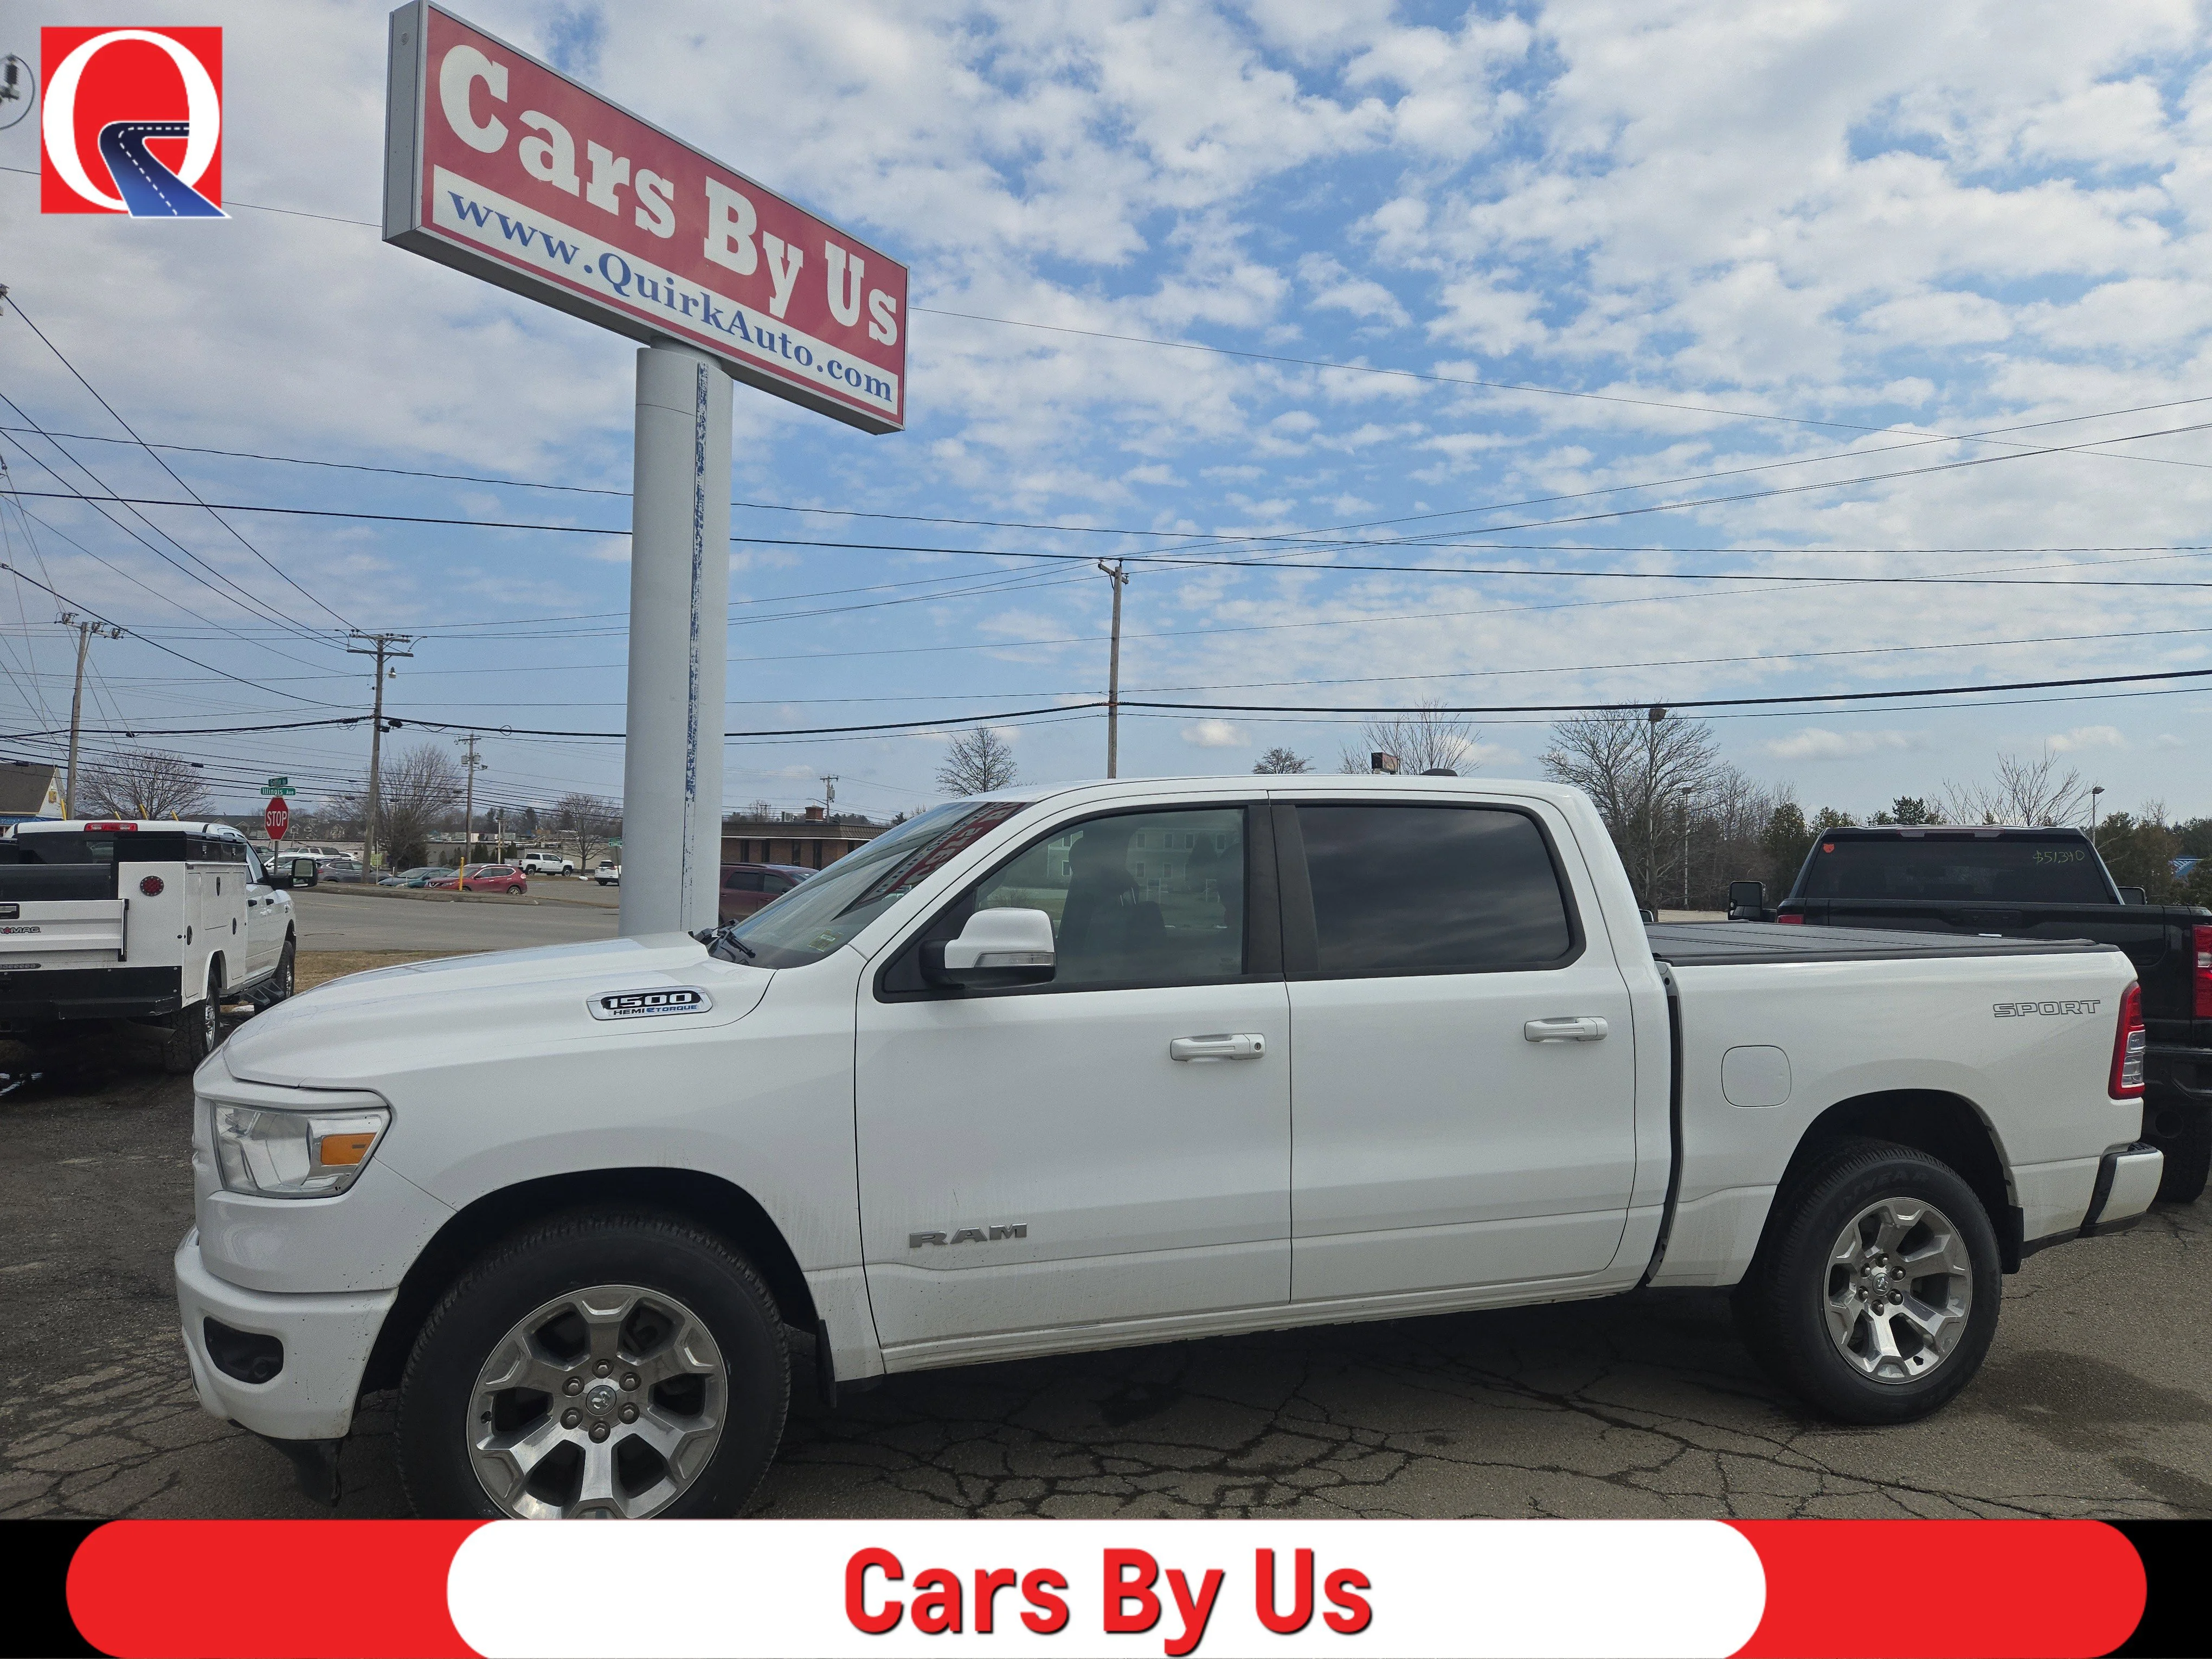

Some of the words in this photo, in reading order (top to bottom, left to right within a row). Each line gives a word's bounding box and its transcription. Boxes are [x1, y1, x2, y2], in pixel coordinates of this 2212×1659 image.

[439, 44, 676, 240] Cars
[704, 176, 803, 319] By
[825, 240, 898, 346] Us
[447, 190, 893, 403] www.QuirkAuto.com
[267, 811, 287, 826] STOP
[607, 993, 692, 1008] 1500
[1992, 1000, 2101, 1018] SPORT
[613, 1007, 645, 1015] HEMI
[909, 1222, 1028, 1248] RAM
